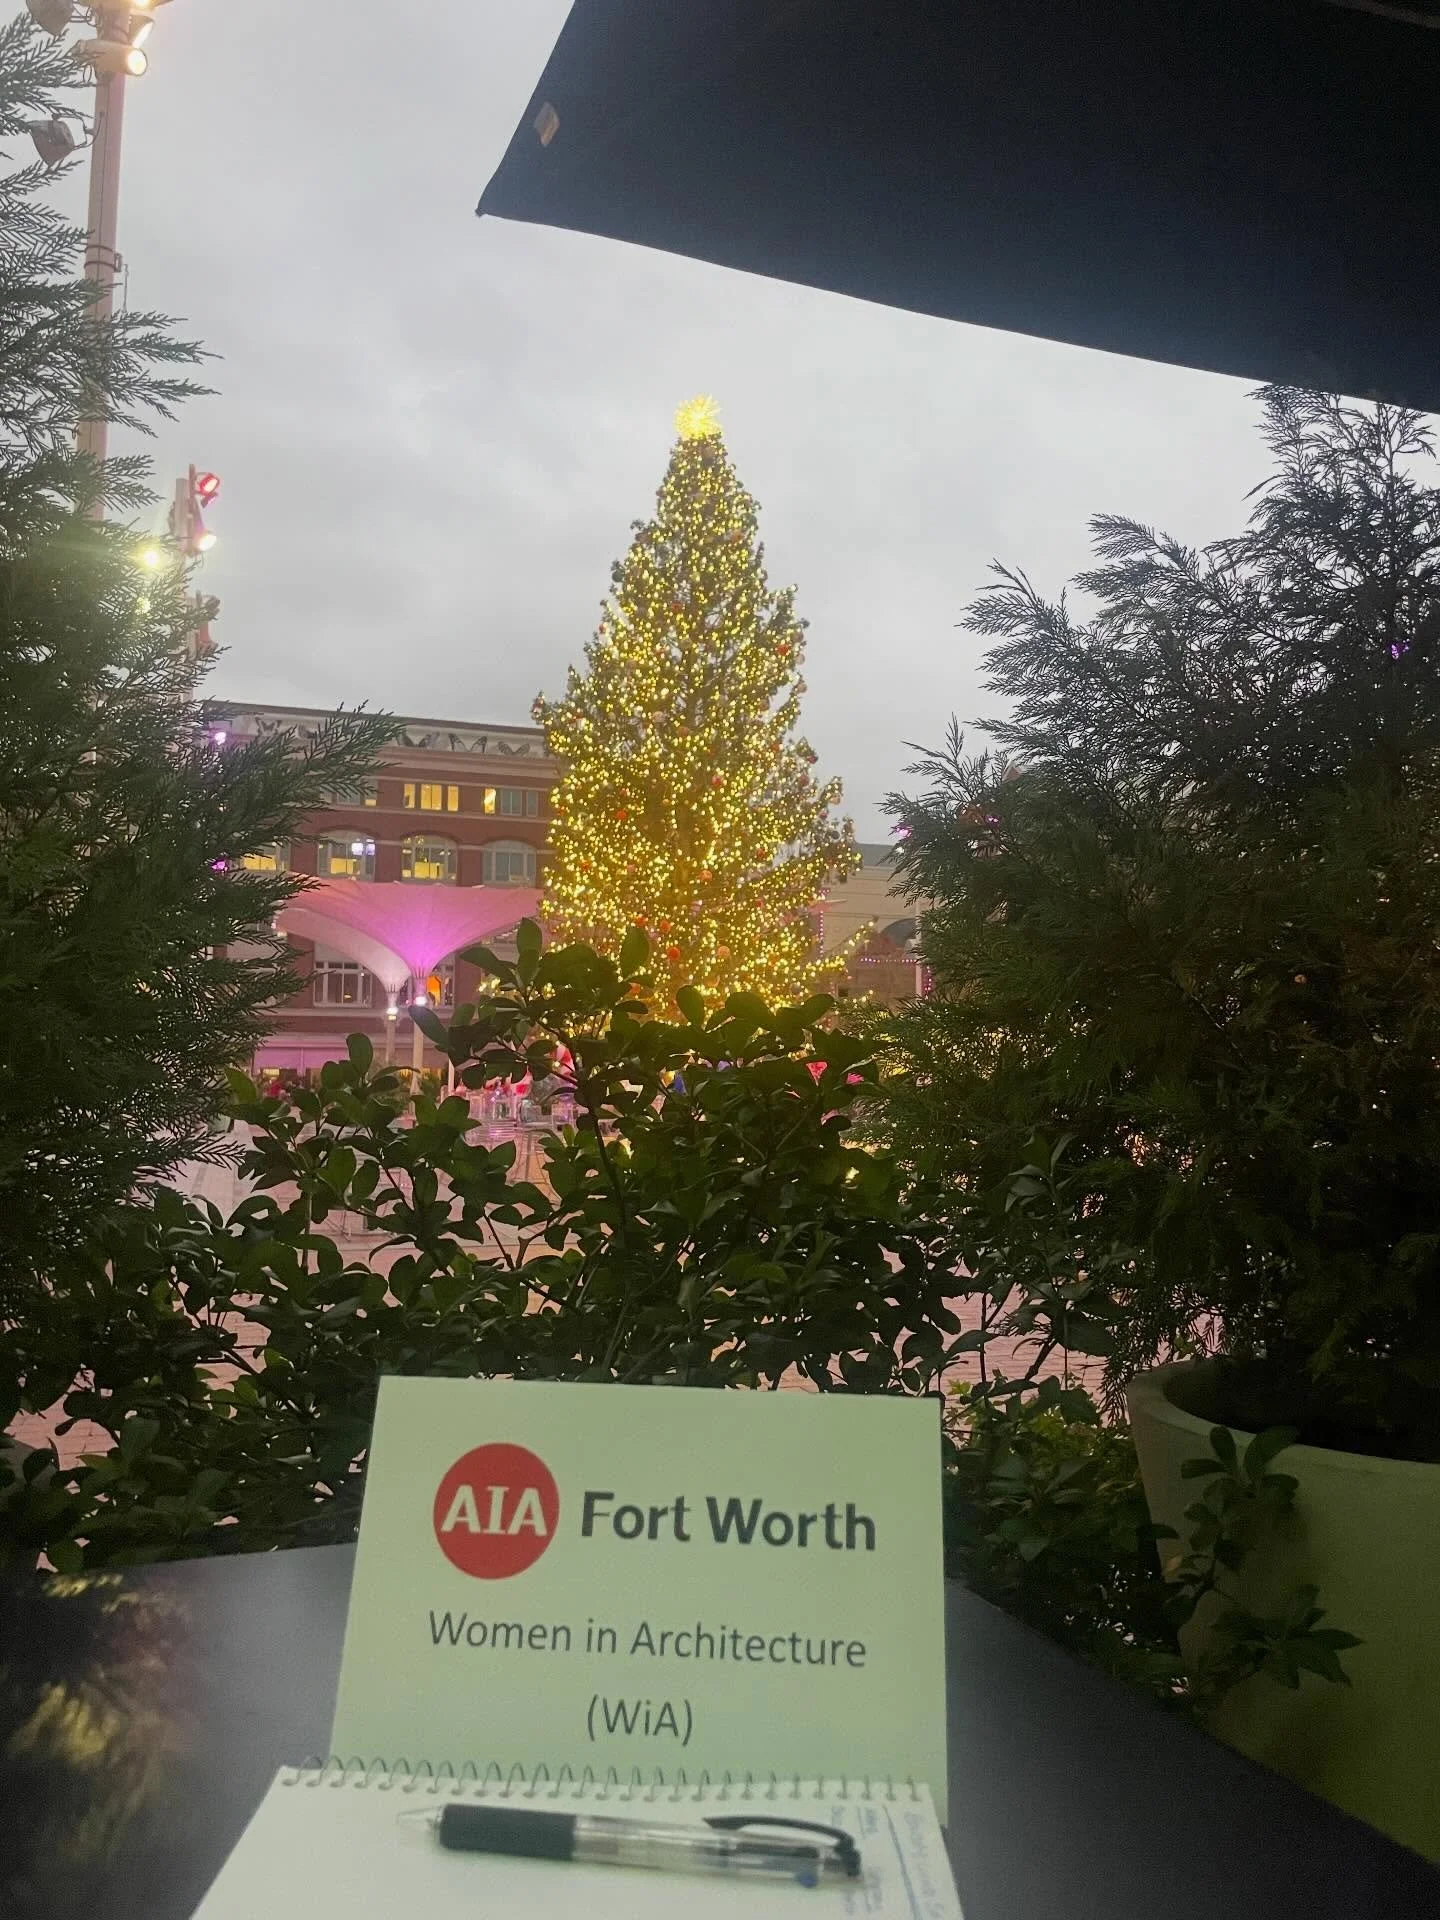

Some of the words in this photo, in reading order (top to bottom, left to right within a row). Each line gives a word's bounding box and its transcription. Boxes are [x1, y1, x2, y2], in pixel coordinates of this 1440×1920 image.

[441, 1485, 547, 1536] AIA
[582, 1491, 691, 1542] Fort
[706, 1496, 876, 1551] Worth
[430, 1611, 572, 1652] Women
[587, 1618, 617, 1653] in
[630, 1621, 867, 1667] Architecture
[587, 1695, 693, 1747] (WiA)
